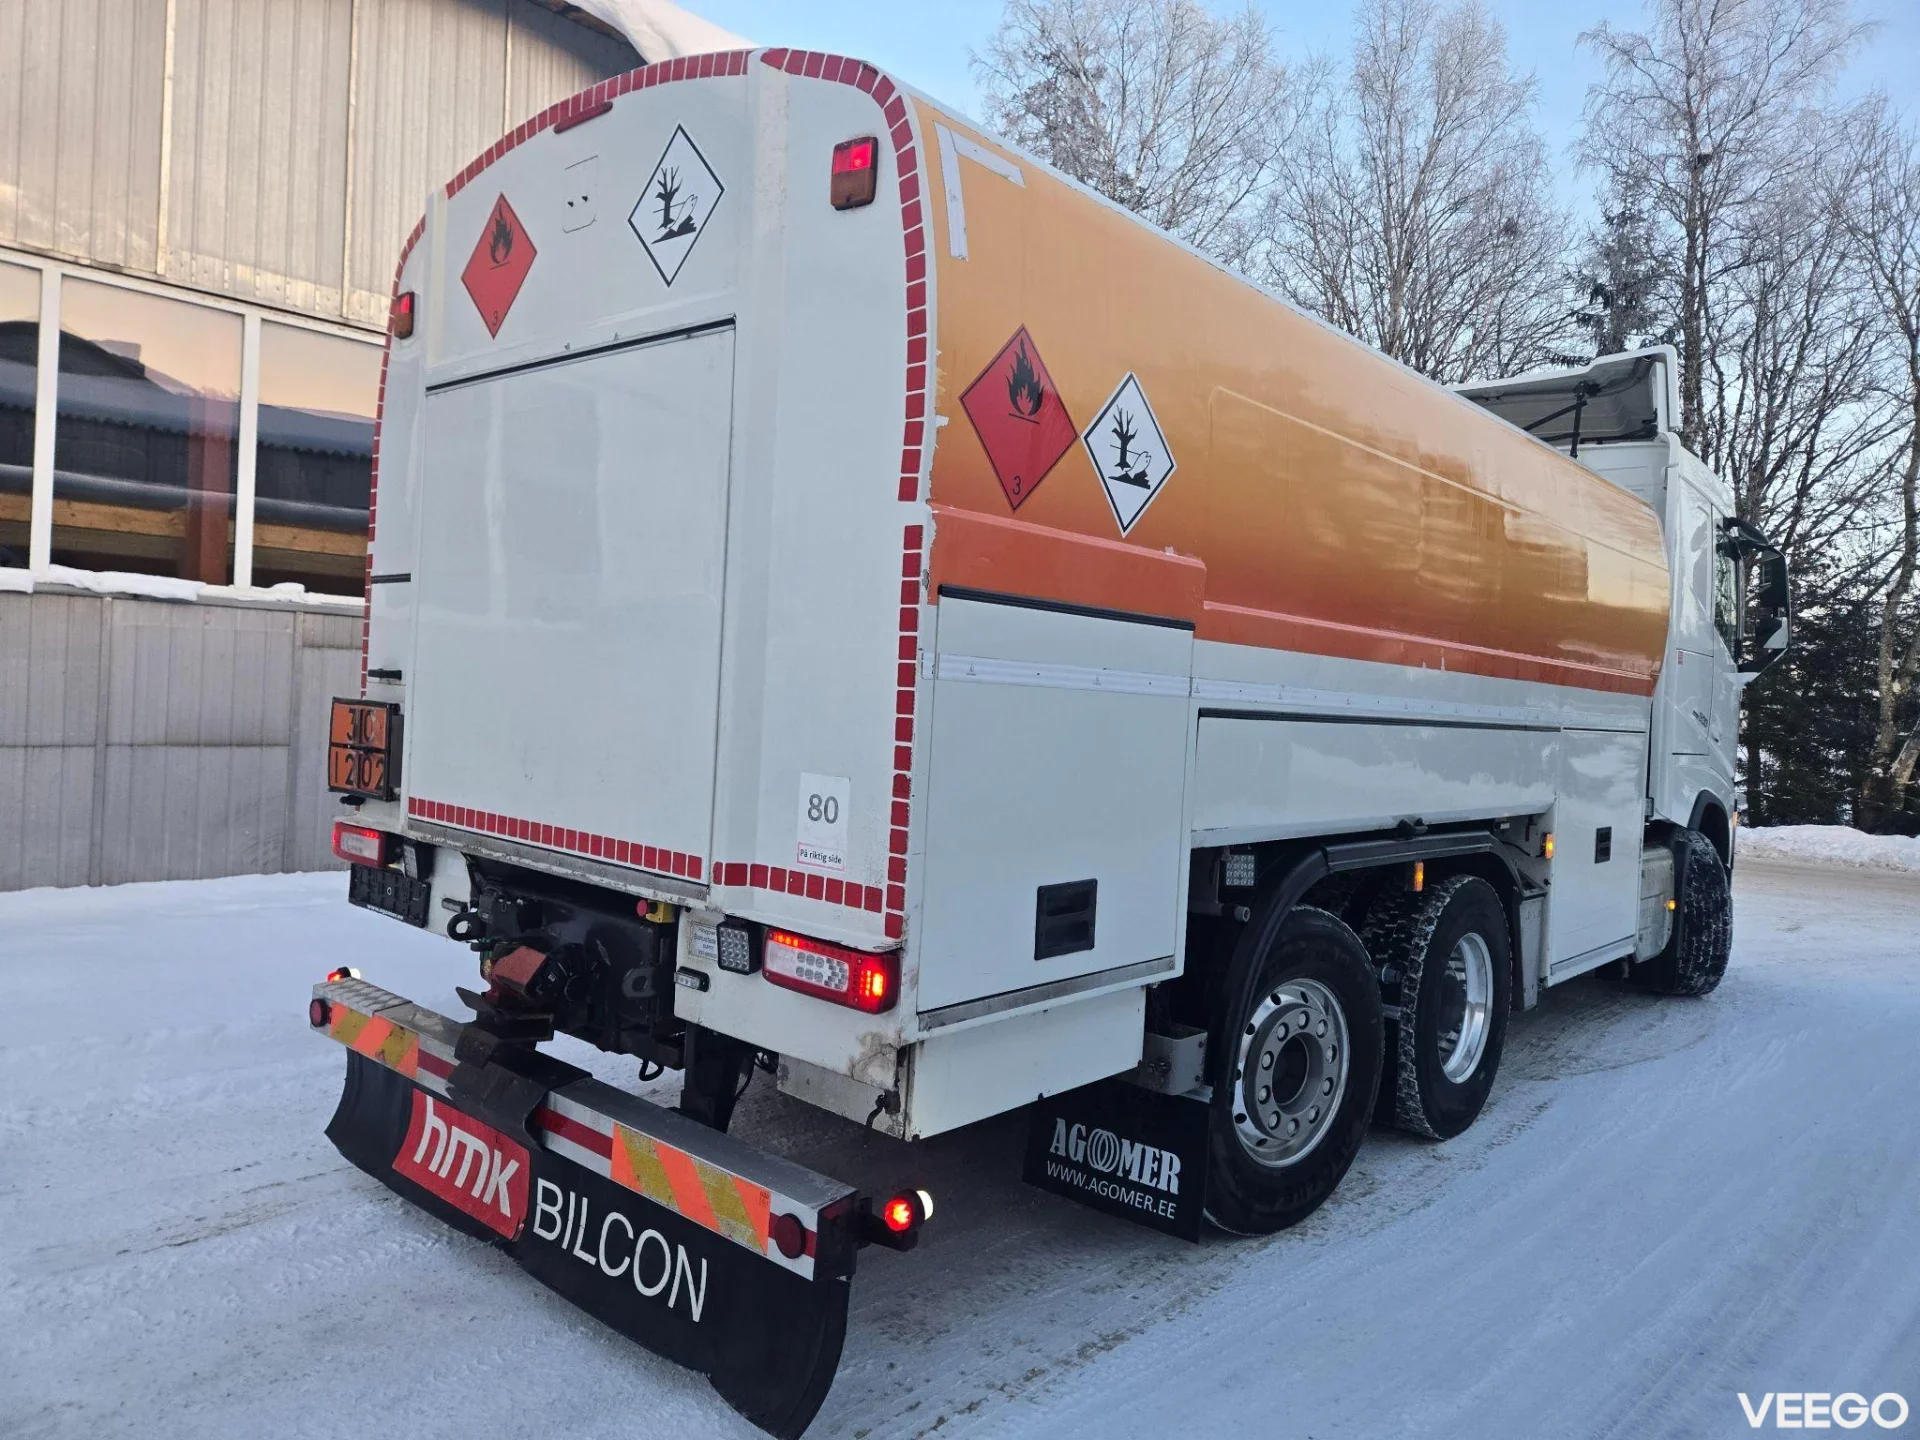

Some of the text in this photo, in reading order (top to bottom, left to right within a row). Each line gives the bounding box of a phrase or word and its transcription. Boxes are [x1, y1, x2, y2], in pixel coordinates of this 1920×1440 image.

[491, 309, 499, 326] 3
[1012, 475, 1022, 496] 3
[334, 751, 385, 790] 1202
[807, 793, 839, 824] 80
[800, 848, 842, 865] På riktig side
[413, 1094, 519, 1218] hmk
[1047, 1160, 1177, 1219] WWW.AGOMER.EE
[533, 1177, 708, 1323] BILCON
